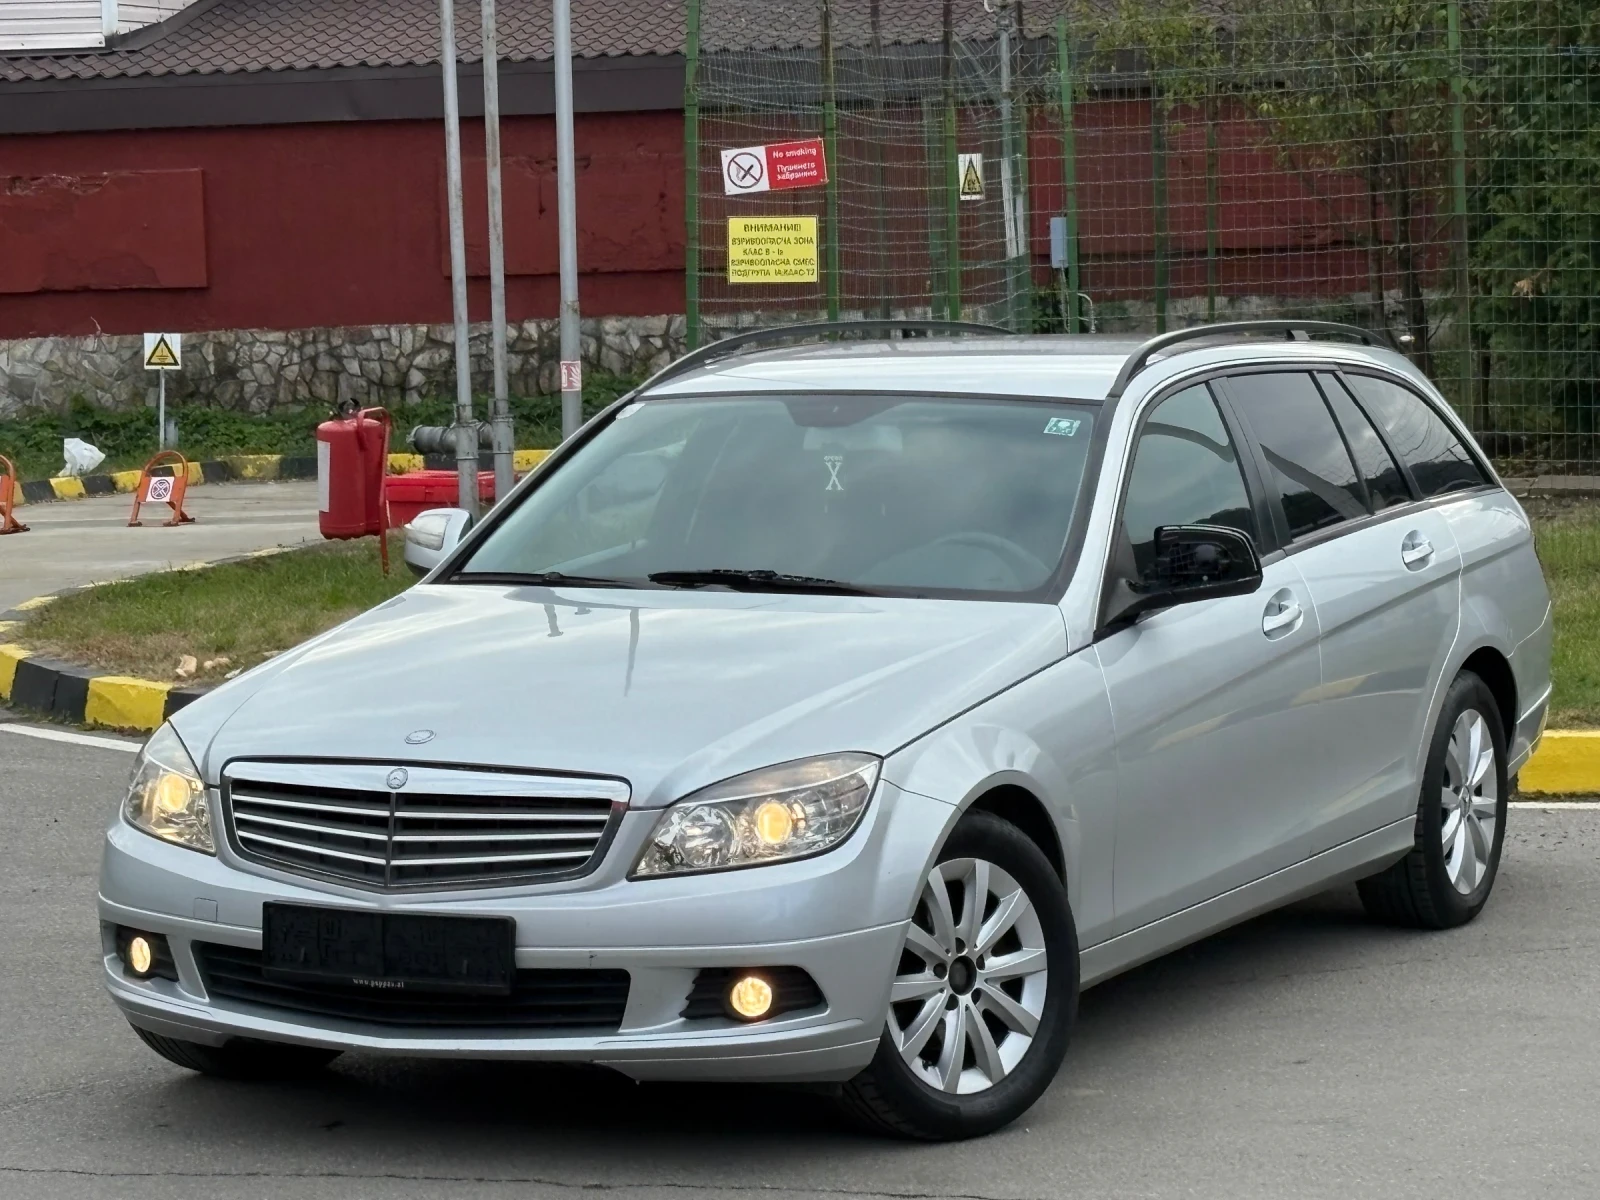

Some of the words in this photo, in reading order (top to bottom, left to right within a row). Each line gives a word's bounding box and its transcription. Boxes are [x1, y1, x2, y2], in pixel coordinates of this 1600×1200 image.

[773, 150, 784, 159] No
[785, 147, 817, 157] smoking
[793, 236, 815, 245] ЗОНА
[742, 248, 764, 256] КЛАС
[824, 461, 845, 491] X
